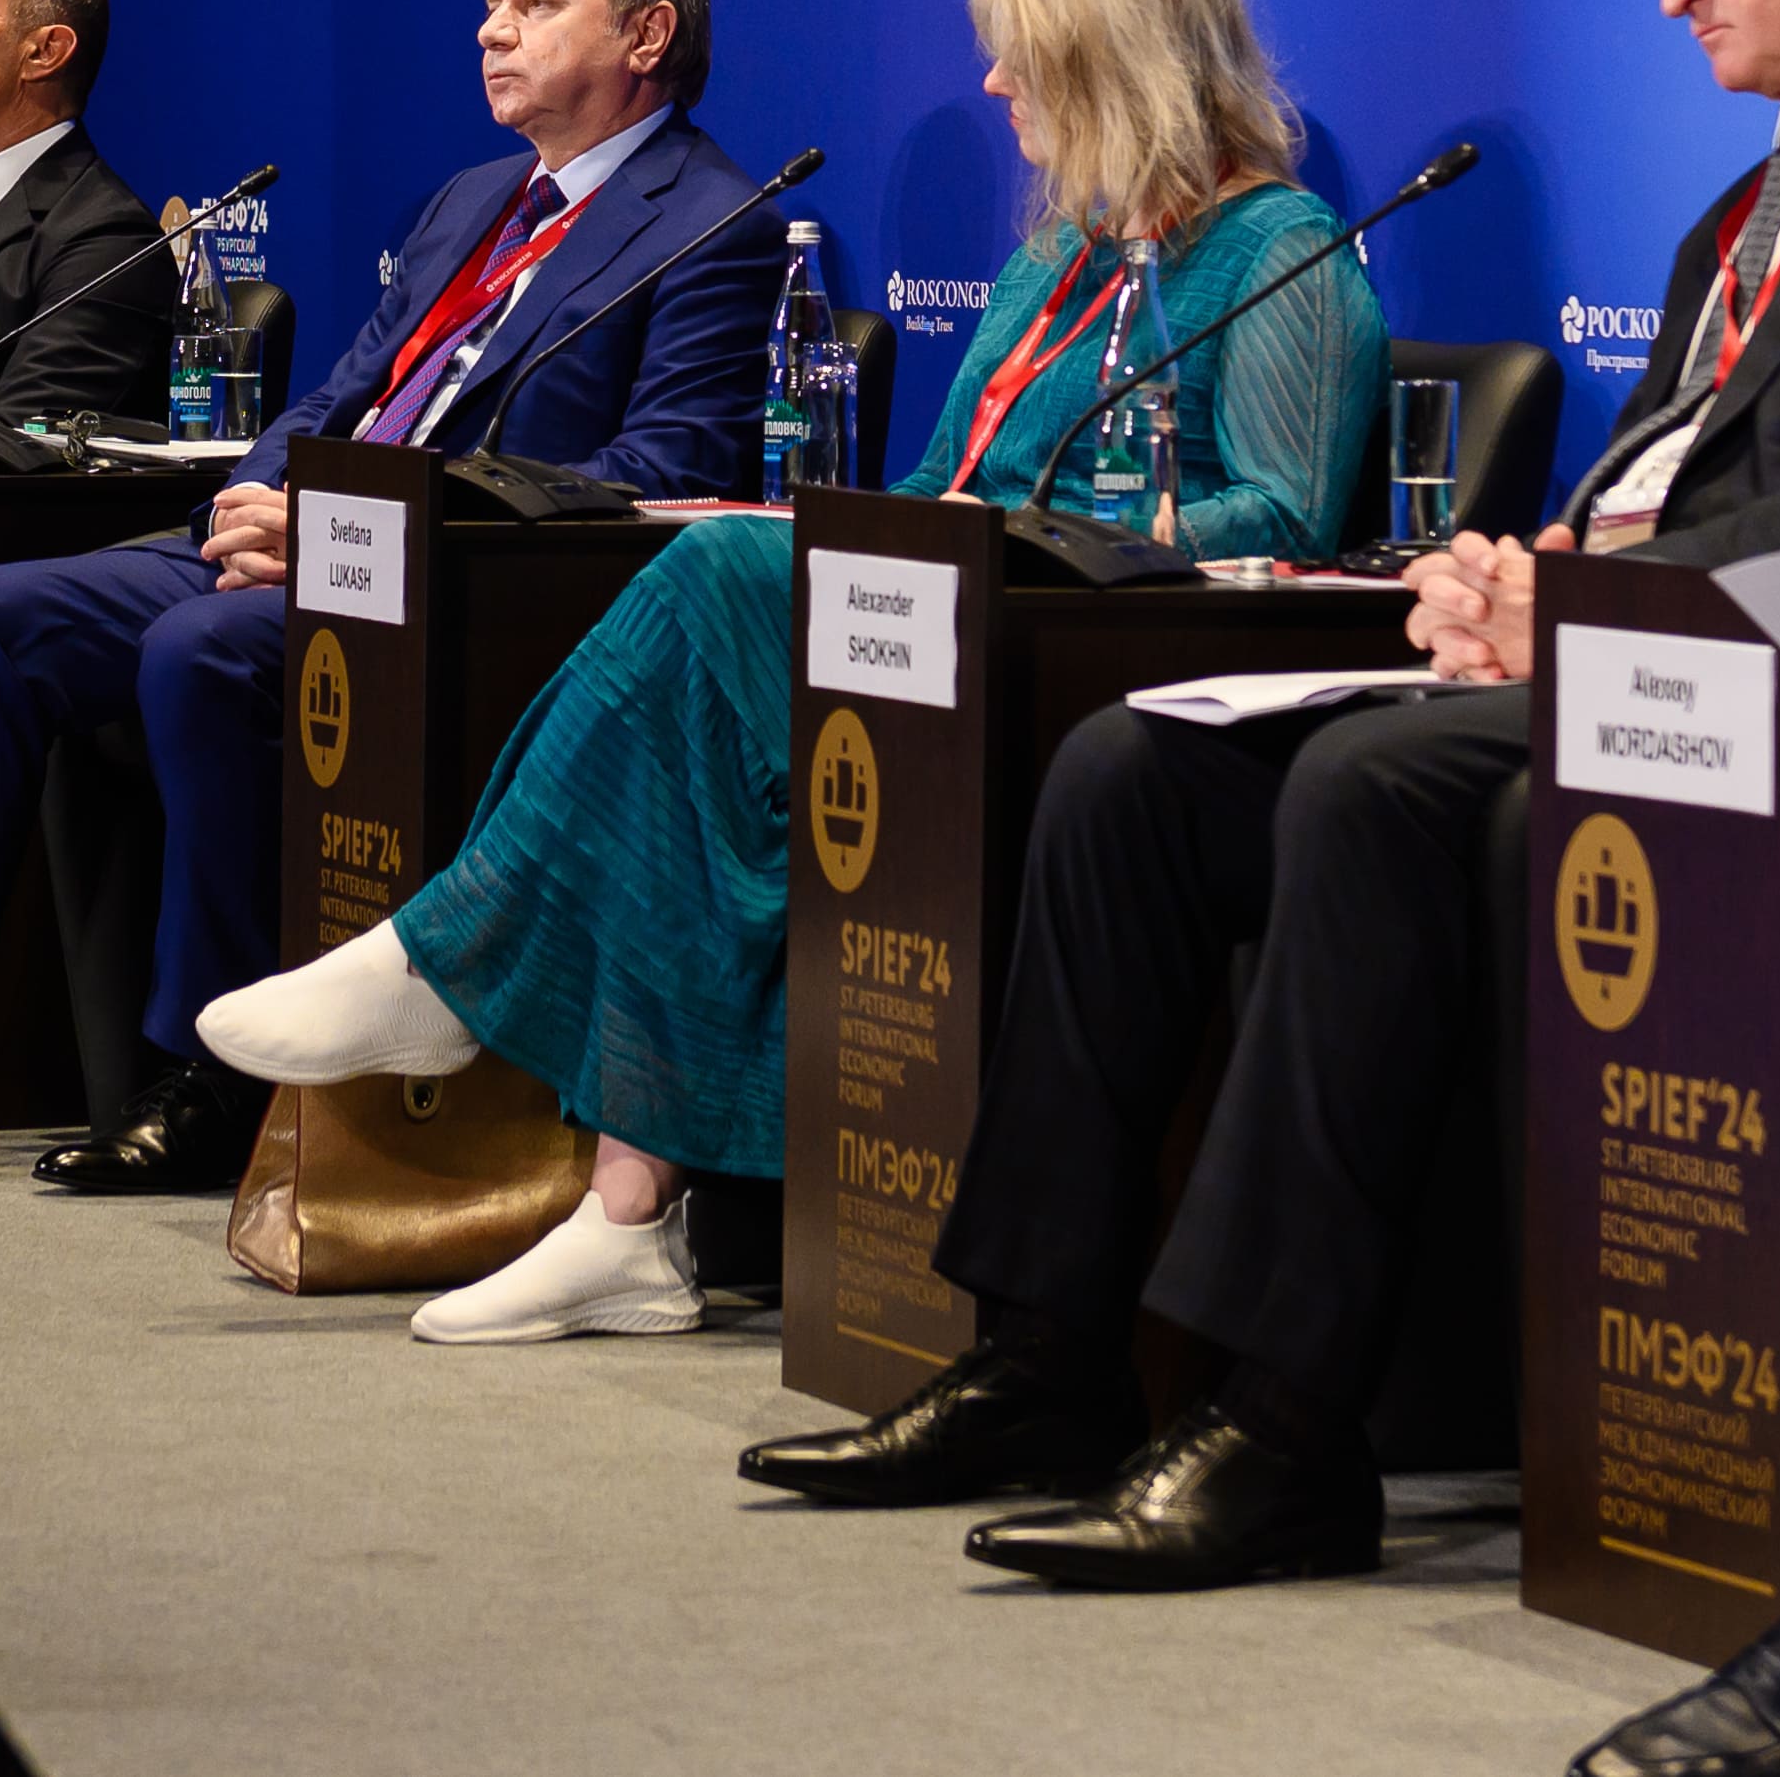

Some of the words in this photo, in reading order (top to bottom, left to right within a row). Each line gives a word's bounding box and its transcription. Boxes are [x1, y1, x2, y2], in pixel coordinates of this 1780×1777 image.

[906, 280, 995, 308] ROSCONGR
[906, 315, 935, 336] Building
[935, 316, 954, 332] Trust
[1586, 306, 1665, 340] РОСКО
[330, 517, 372, 548] Svetlana
[329, 562, 372, 594] LUKASH
[846, 583, 915, 619] Alexander
[848, 634, 912, 671] SHOKHIN
[321, 811, 402, 877] SPIEF'24
[321, 867, 333, 891] ST.
[333, 870, 391, 906] PETERSBURG
[840, 919, 952, 997] SPIEF'24
[858, 990, 936, 1031] PETERSBURG
[839, 1016, 940, 1066] INTERNATIONAL
[839, 1046, 905, 1087] ECONOMIC
[839, 1076, 884, 1112] FORUM
[1601, 1062, 1767, 1156] SPIEF'24
[1626, 1144, 1742, 1196] PETERSBURG
[1600, 1176, 1749, 1236] INTERNATIONAL
[1600, 1213, 1700, 1261] ECONOMIC
[1600, 1248, 1667, 1290] FORUM
[1599, 1305, 1780, 1415] ПМЭФ'24
